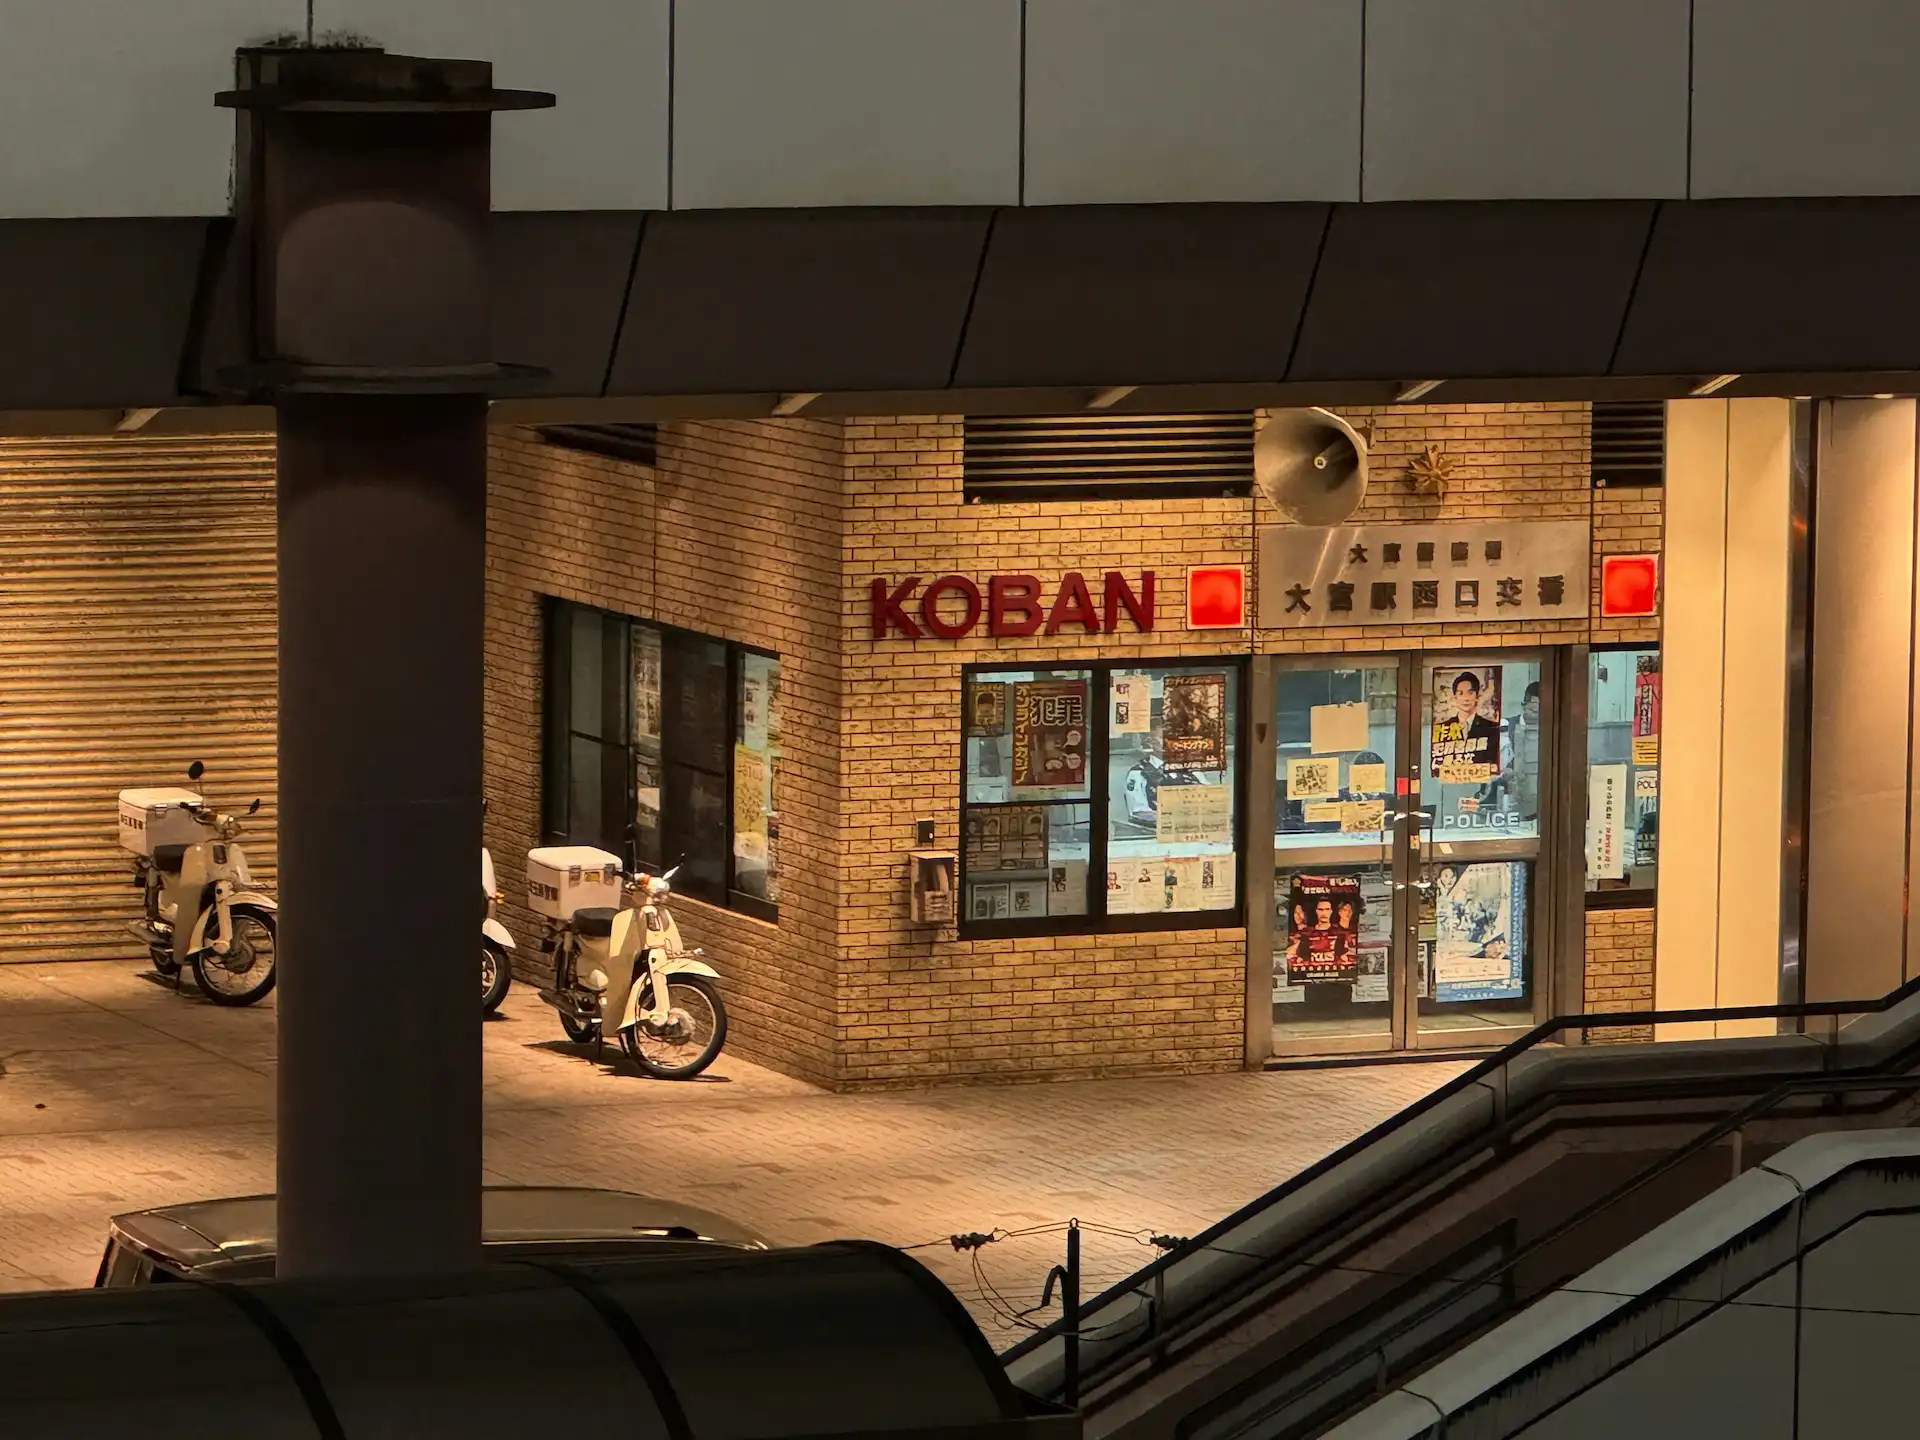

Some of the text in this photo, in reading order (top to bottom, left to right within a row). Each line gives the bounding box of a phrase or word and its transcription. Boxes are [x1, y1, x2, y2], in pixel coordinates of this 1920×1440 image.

[871, 570, 1155, 639] KOBAN
[1030, 695, 1084, 727] 犯罪
[1443, 811, 1519, 830] POLICE
